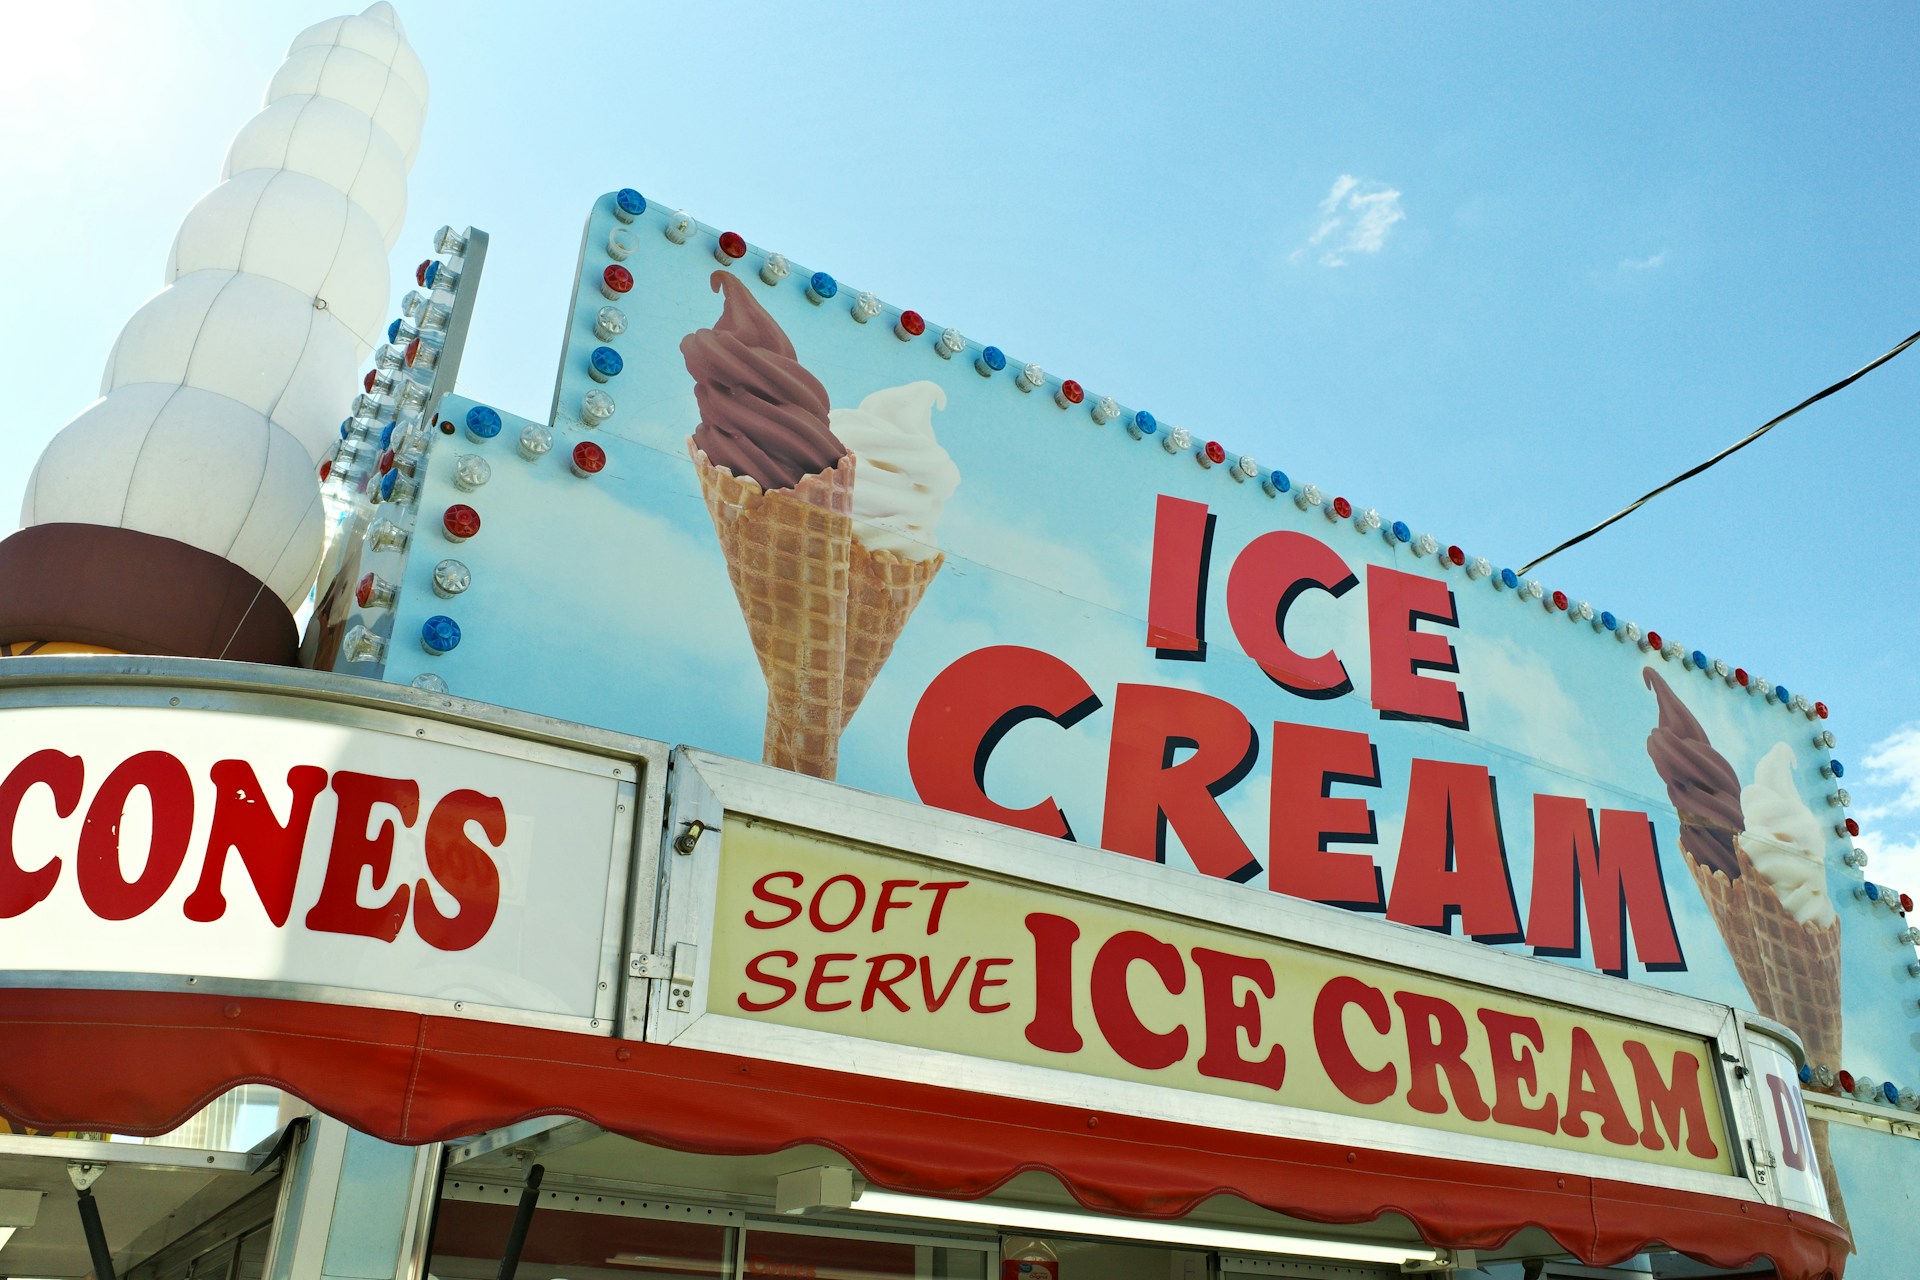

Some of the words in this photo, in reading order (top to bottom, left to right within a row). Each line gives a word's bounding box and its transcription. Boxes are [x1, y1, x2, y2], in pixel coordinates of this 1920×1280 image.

[1147, 493, 1469, 732] ICE
[0, 749, 507, 951] CONES
[744, 871, 969, 936] SOFT
[907, 645, 1687, 980] CREAM
[737, 950, 1014, 1014] SERVE
[1024, 912, 1287, 1091] ICE
[1313, 975, 1718, 1160] CREAM
